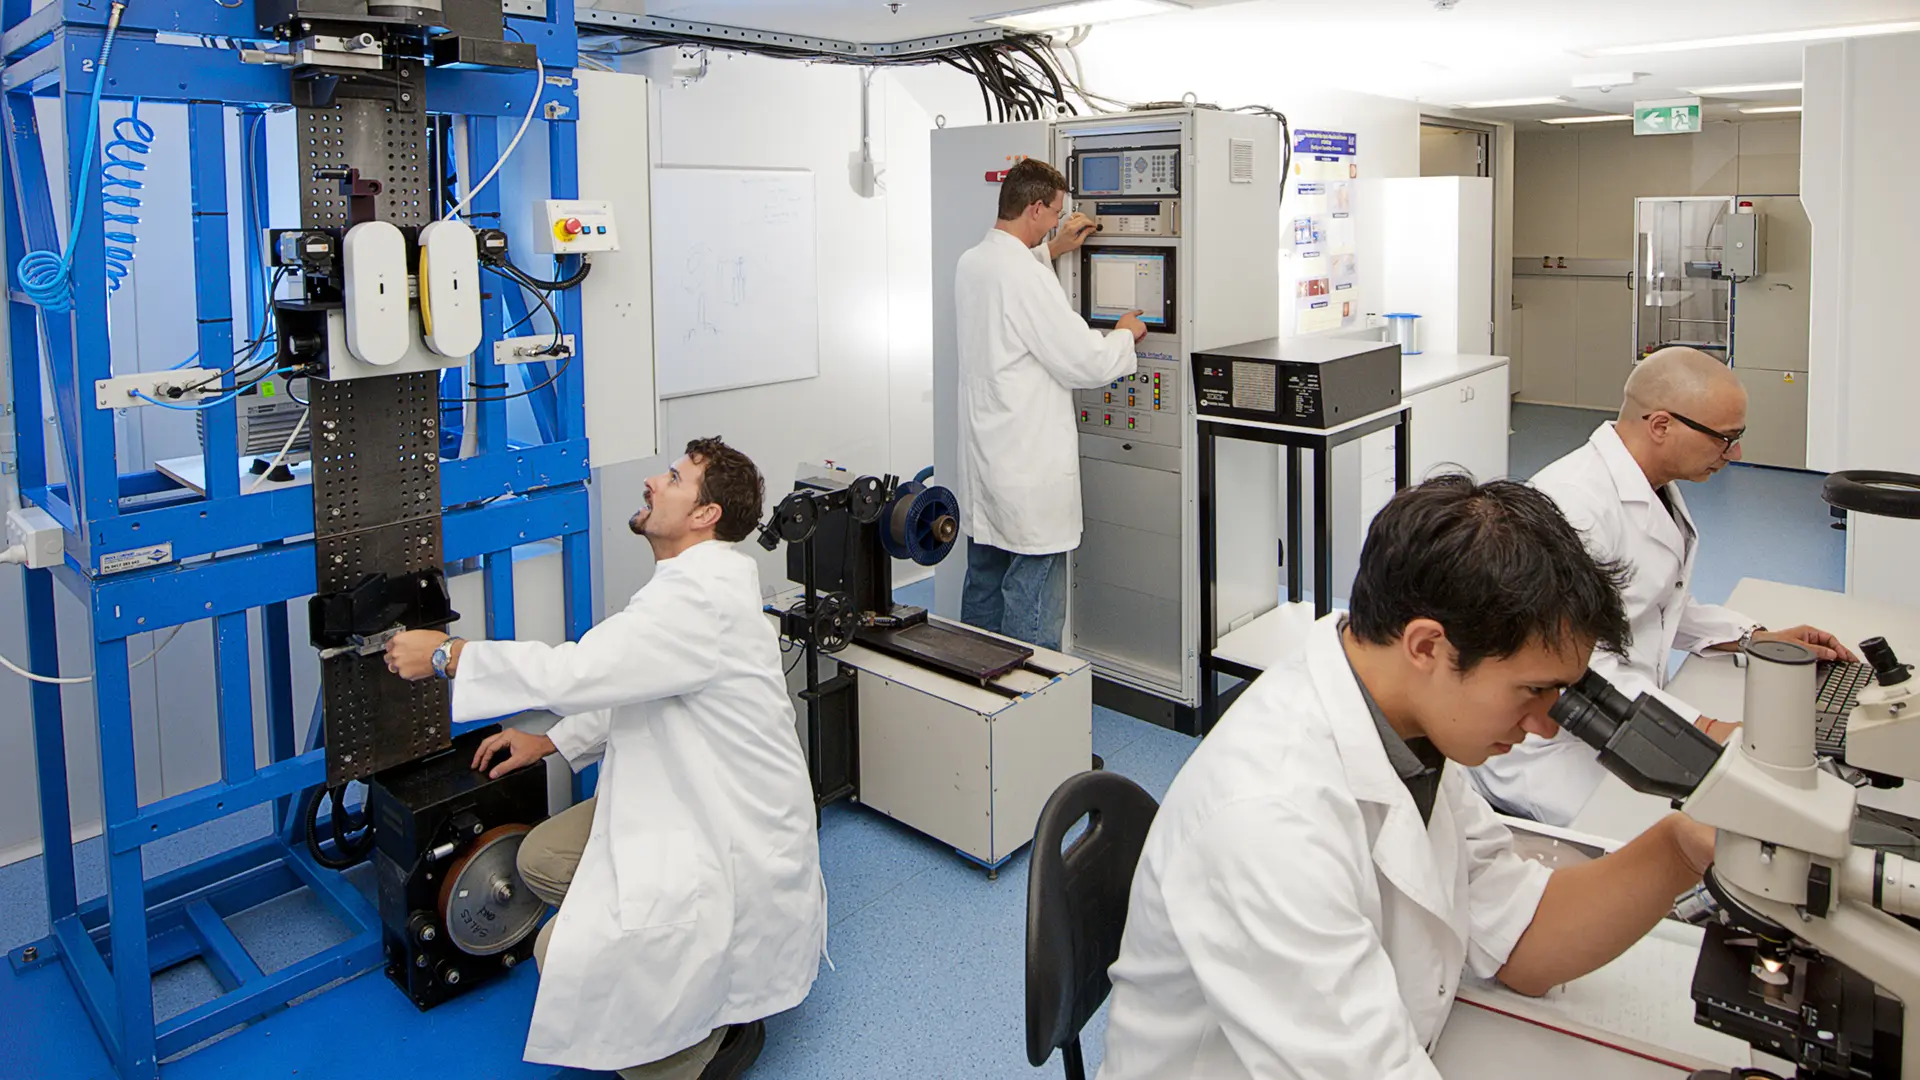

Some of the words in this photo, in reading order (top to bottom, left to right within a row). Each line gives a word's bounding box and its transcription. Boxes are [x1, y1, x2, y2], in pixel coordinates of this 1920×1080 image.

[82, 59, 94, 72] 2
[99, 532, 106, 545] 1
[460, 909, 489, 937] SALES
